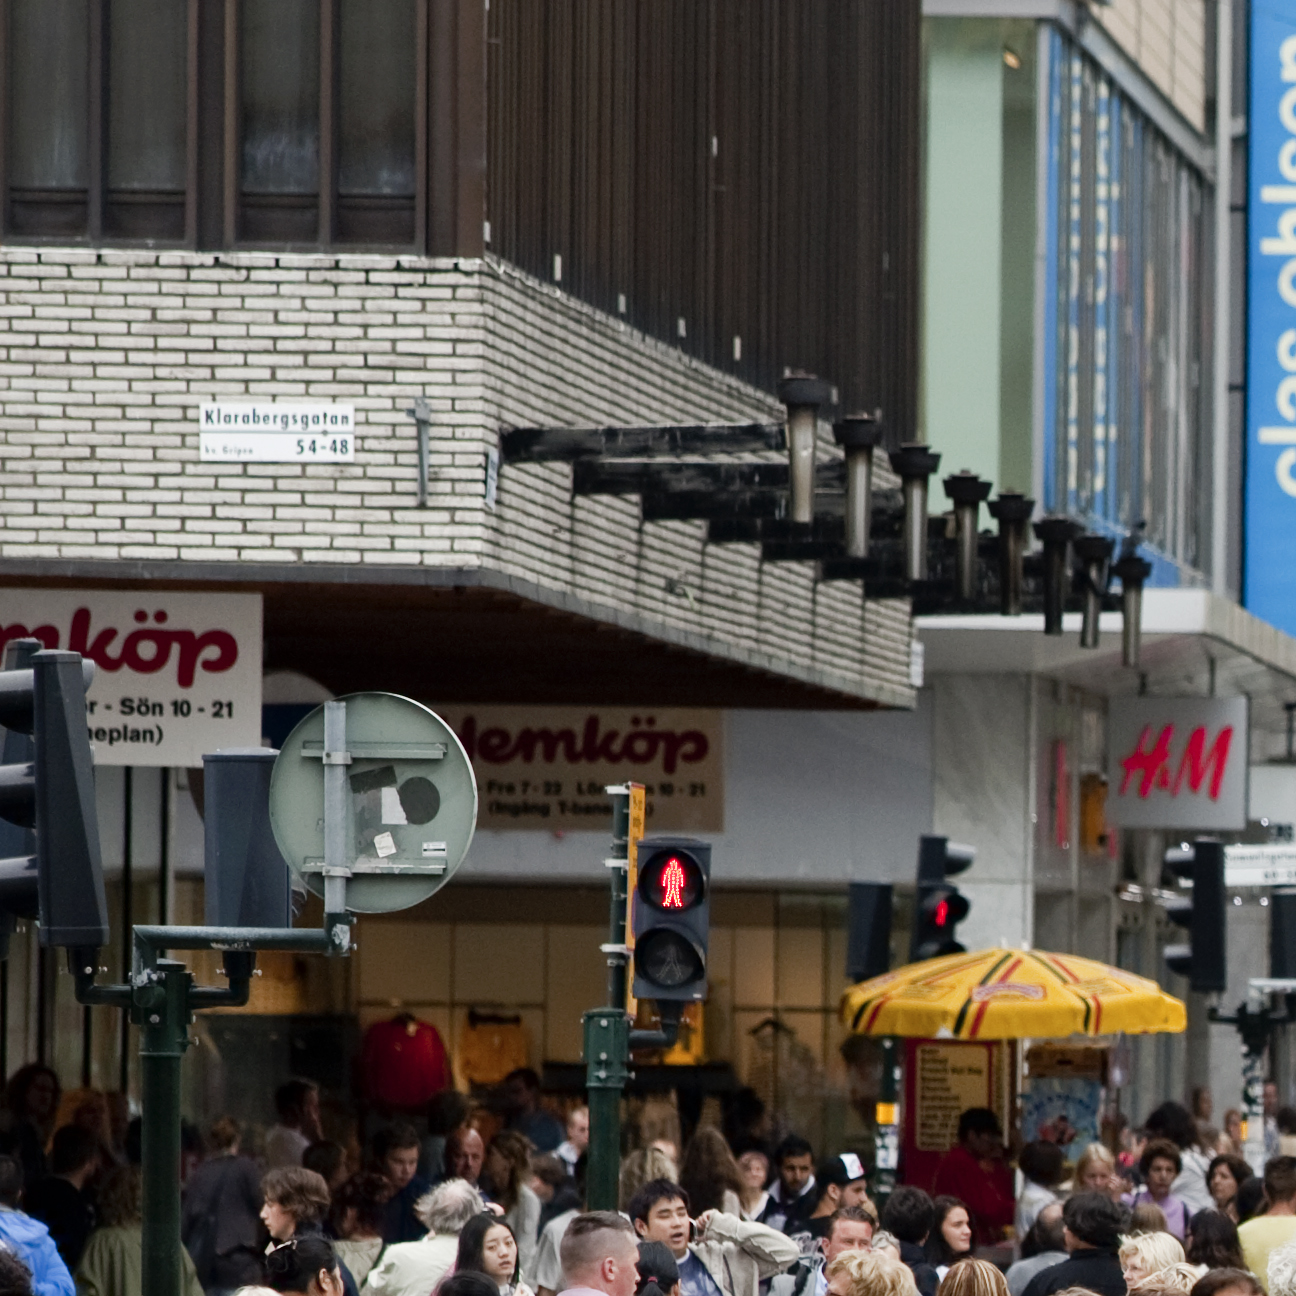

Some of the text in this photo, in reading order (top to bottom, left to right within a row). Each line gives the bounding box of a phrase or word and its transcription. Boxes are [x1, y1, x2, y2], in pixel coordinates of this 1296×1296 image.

[205, 408, 349, 431] Klarabergsgatan
[296, 439, 349, 455] 54-48
[0, 606, 239, 689] mköp
[120, 696, 164, 717] Sön
[171, 699, 192, 717] 10
[211, 700, 234, 719] 21
[1119, 723, 1234, 802] H&M
